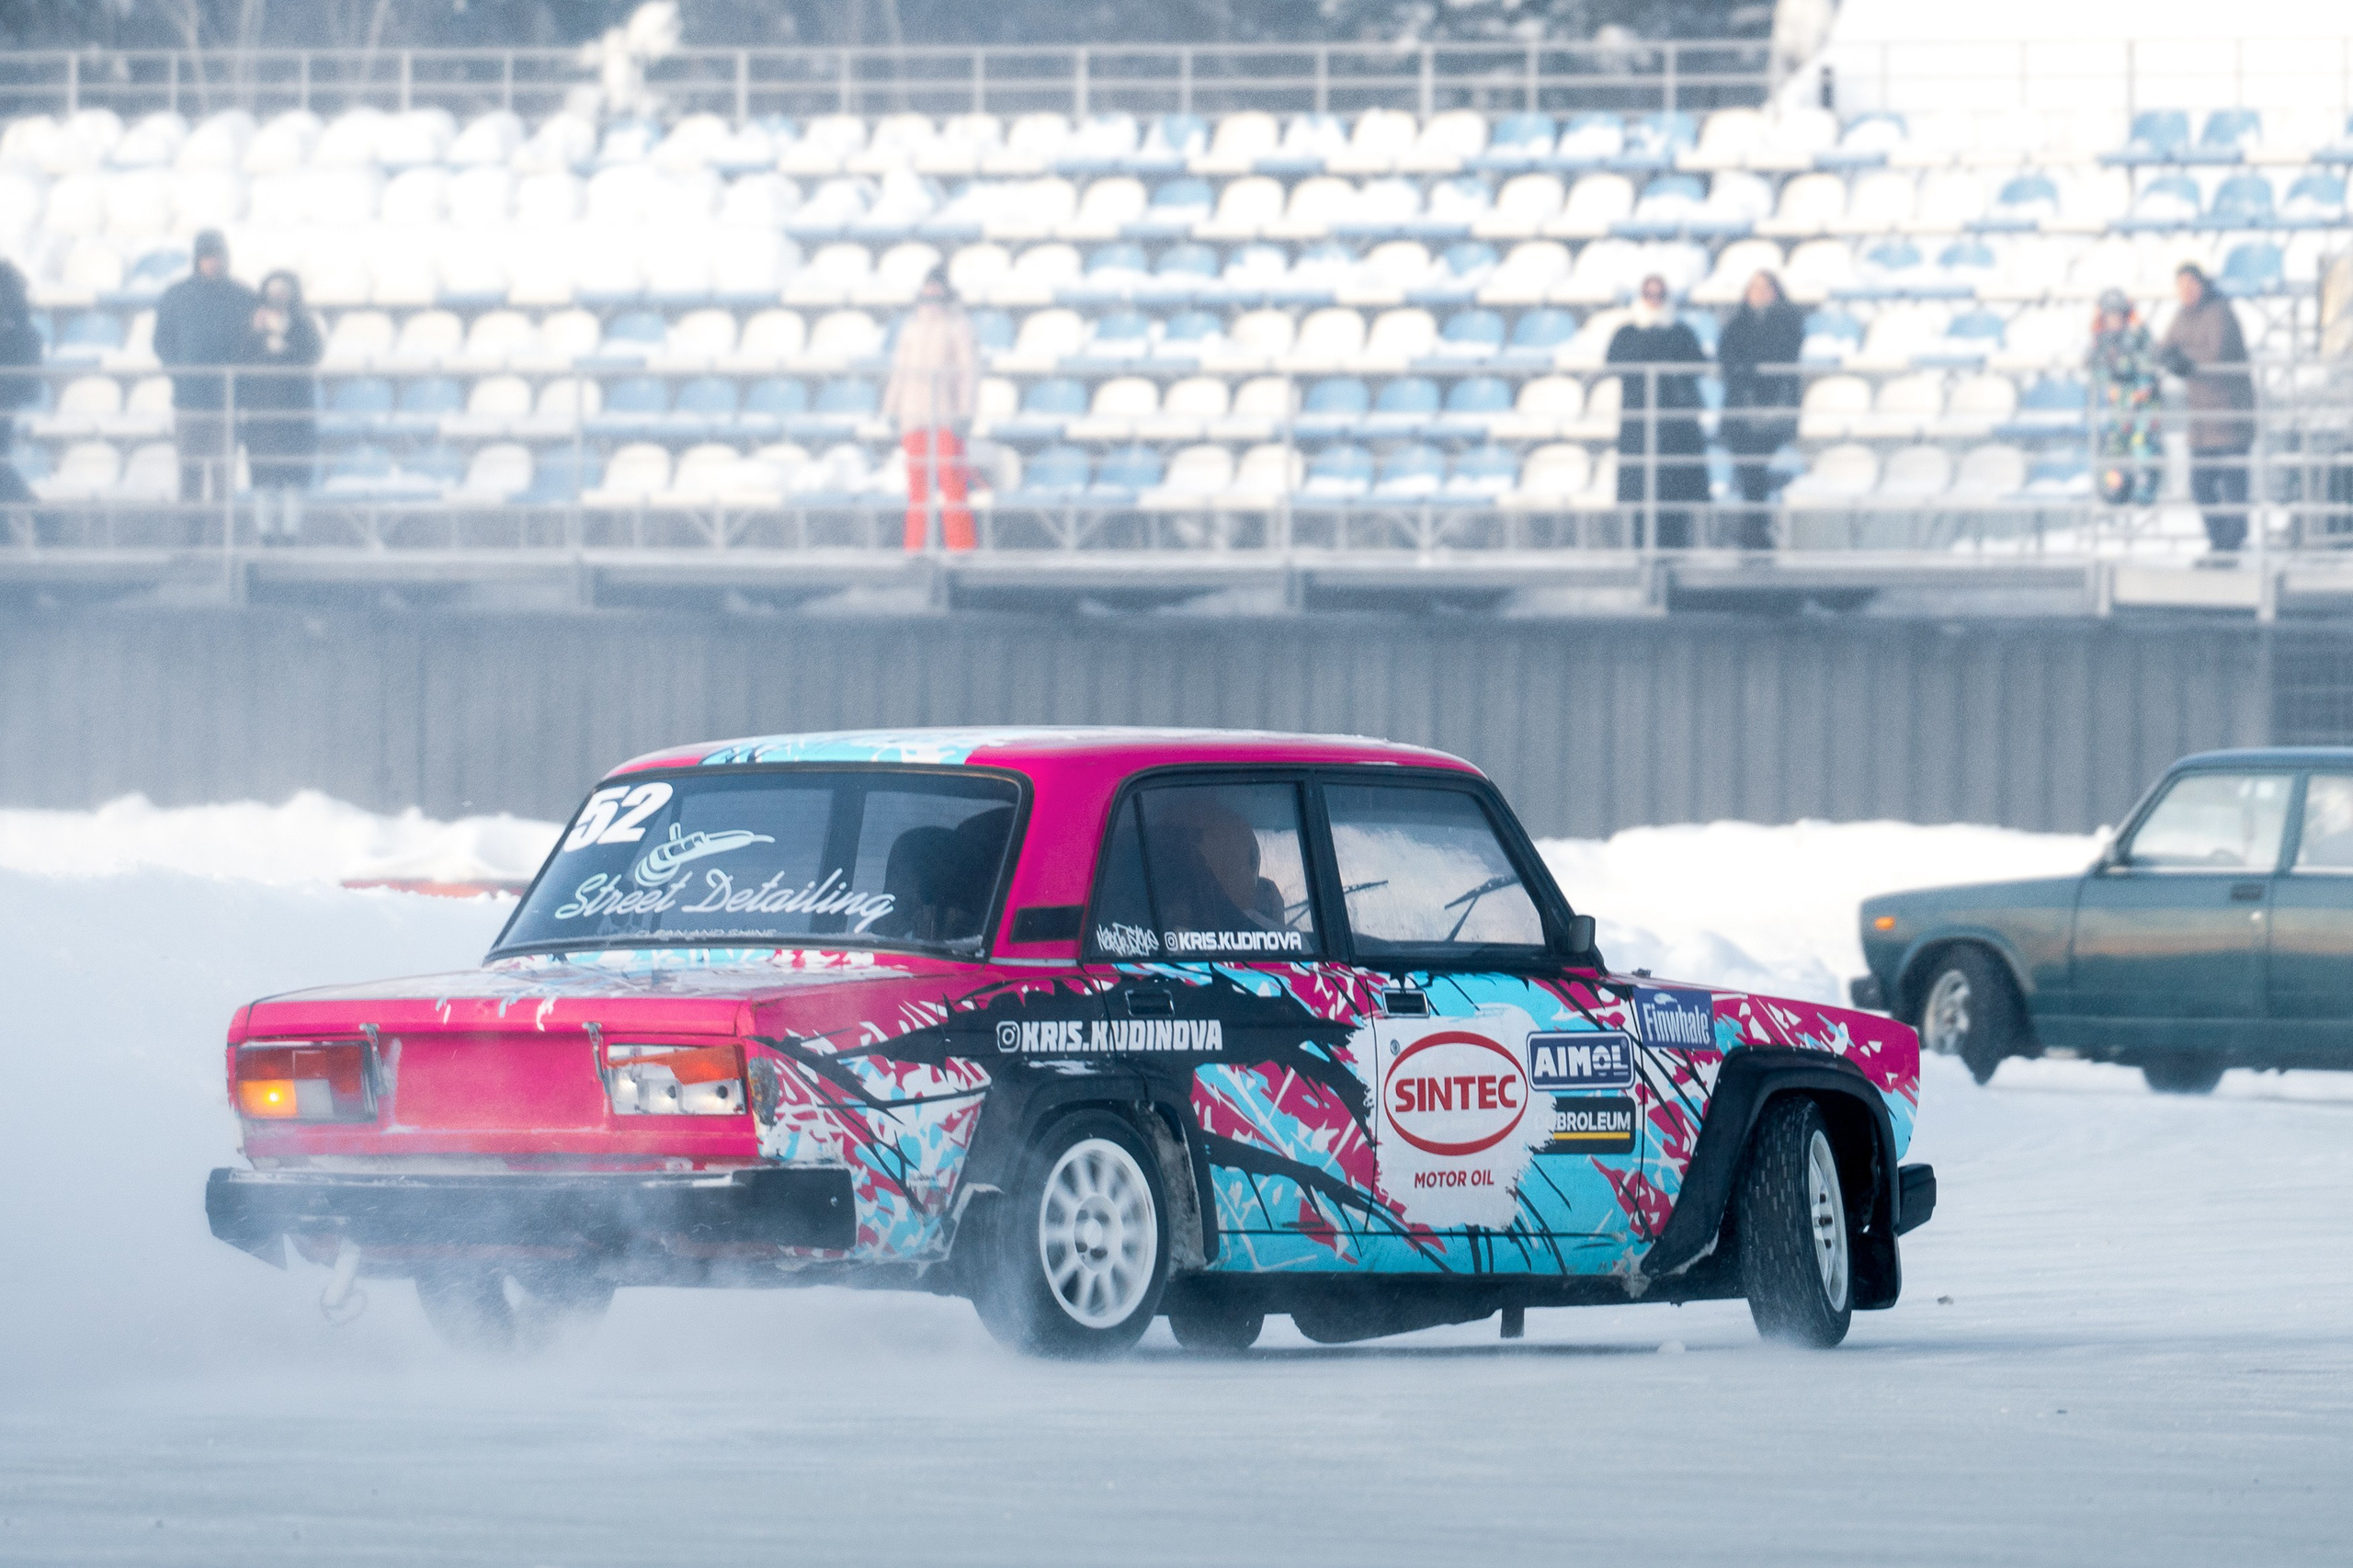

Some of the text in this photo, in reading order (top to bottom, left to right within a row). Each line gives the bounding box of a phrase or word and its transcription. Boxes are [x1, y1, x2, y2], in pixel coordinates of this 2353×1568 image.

[563, 782, 674, 853] 52
[554, 868, 896, 934] Street Detailing
[1178, 931, 1302, 951] KRIS.KUDINOVA
[1021, 1019, 1223, 1052] KRIS.KUDINOVA
[1642, 1003, 1711, 1045] Finwhale
[1533, 1044, 1629, 1078] AIMOL
[1394, 1074, 1518, 1113] SINTEC
[1414, 1169, 1495, 1189] MOTOR OIL
